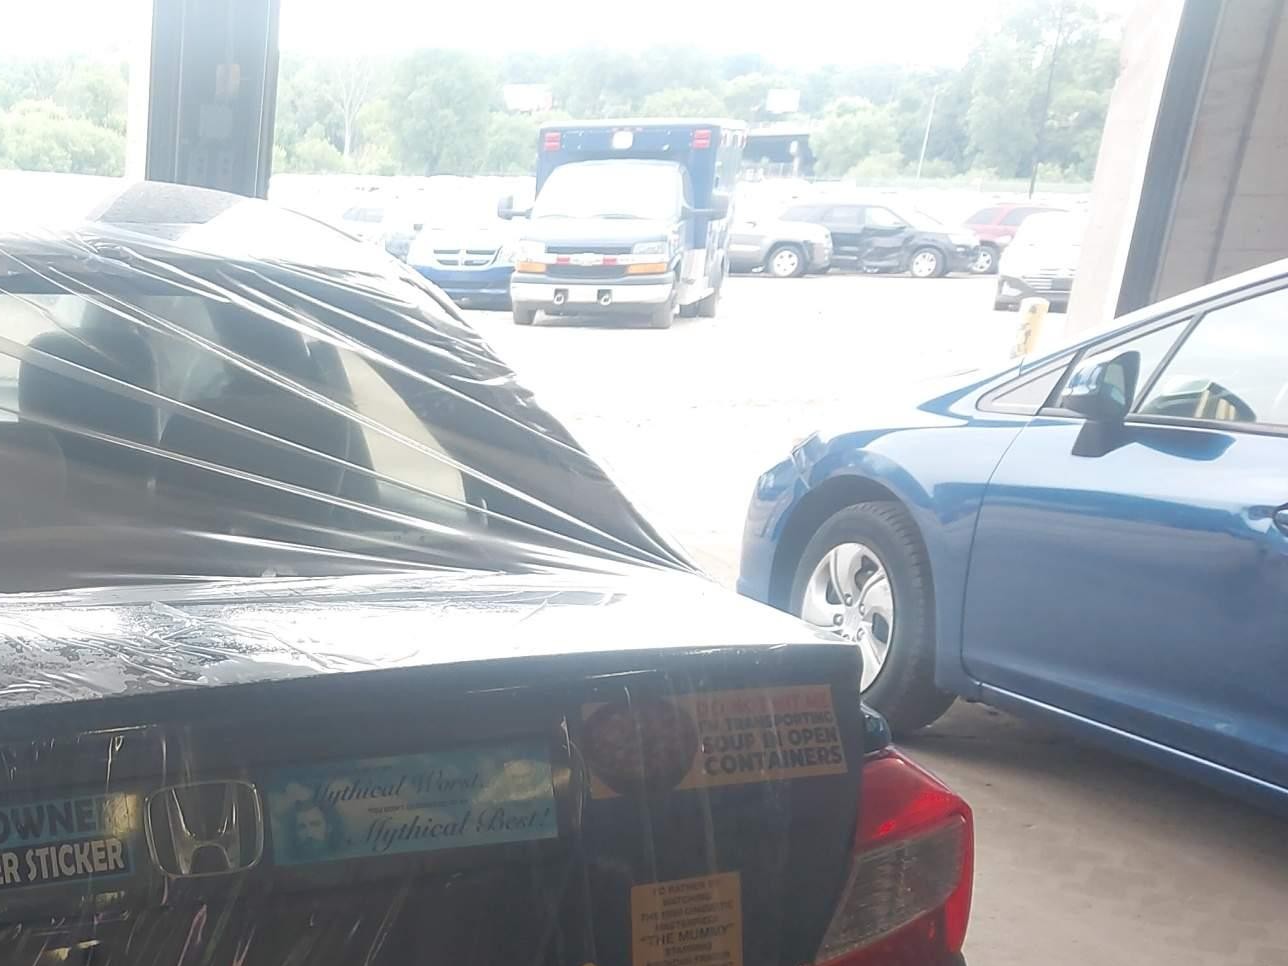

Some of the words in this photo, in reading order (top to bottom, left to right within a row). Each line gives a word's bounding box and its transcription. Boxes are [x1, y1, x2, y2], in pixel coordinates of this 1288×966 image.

[725, 710, 834, 732] TRANSPORTING
[704, 734, 755, 754] SOUP
[787, 726, 838, 745] OPEN
[704, 746, 843, 776] CONTAINERS
[349, 811, 469, 853] Mythical
[475, 806, 551, 832] Best!
[25, 836, 126, 882] STICKER
